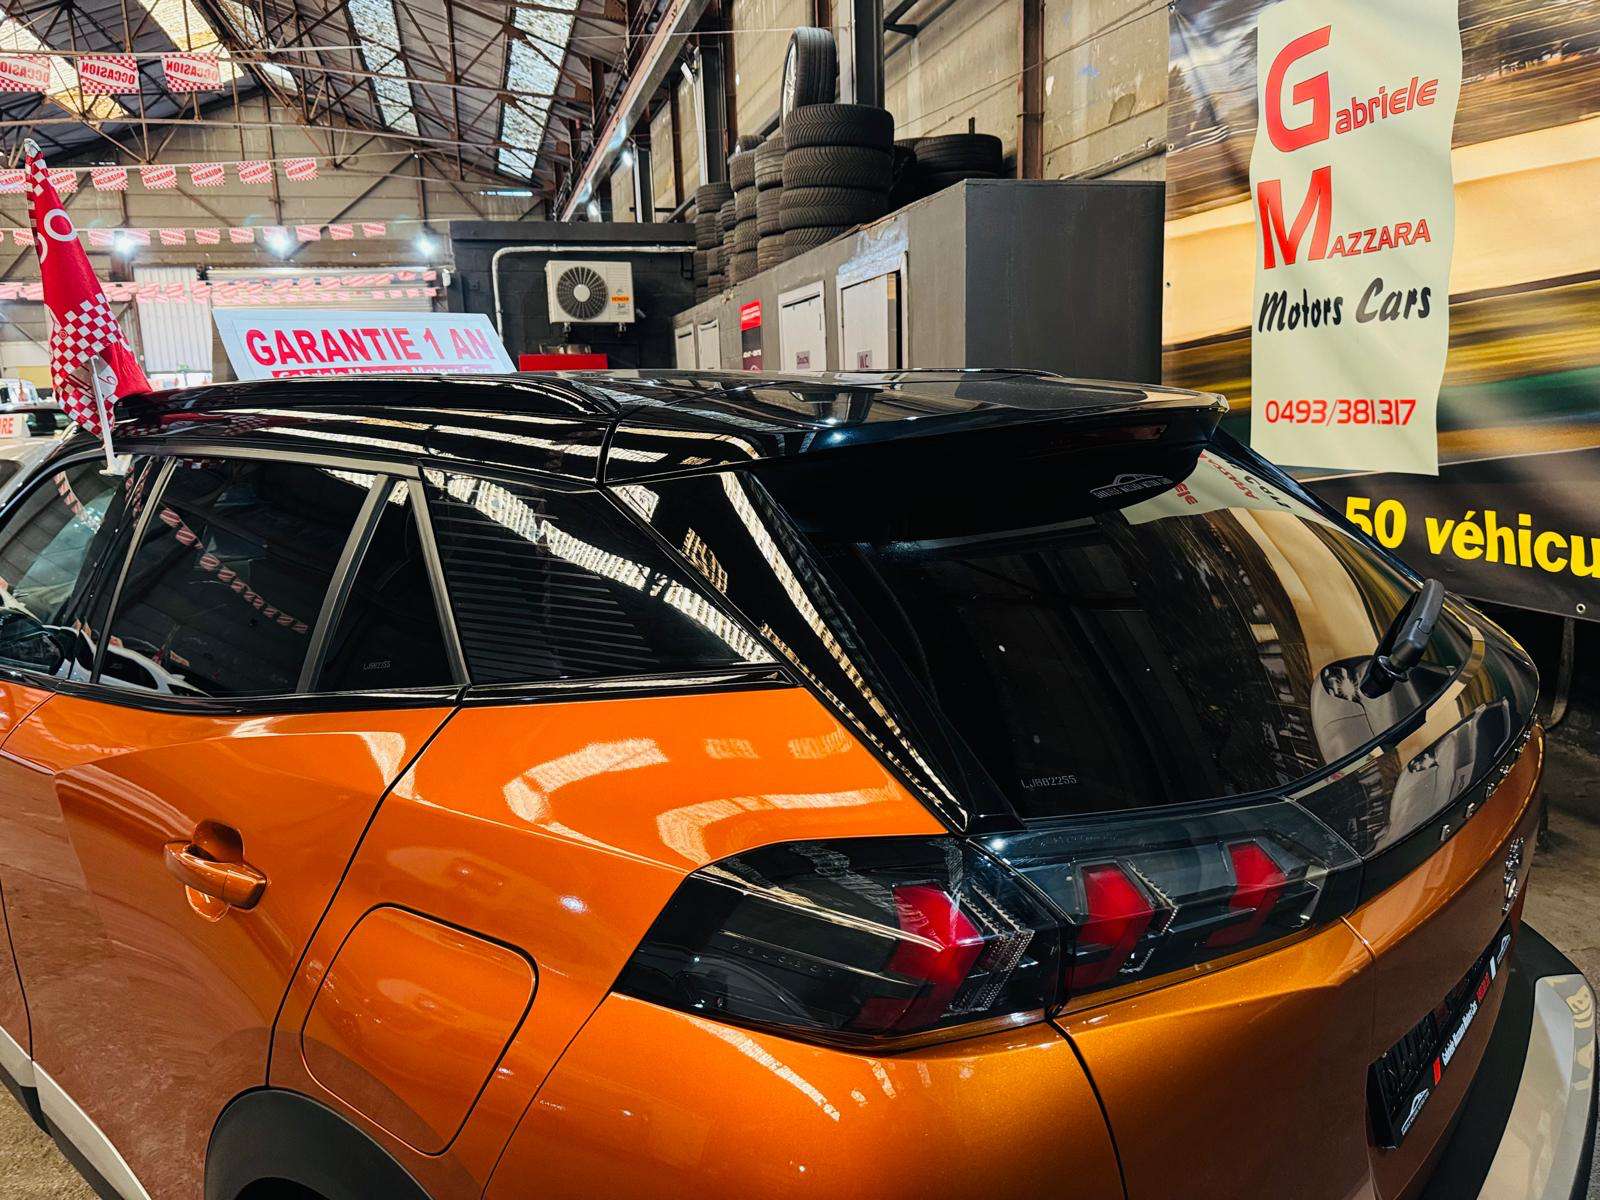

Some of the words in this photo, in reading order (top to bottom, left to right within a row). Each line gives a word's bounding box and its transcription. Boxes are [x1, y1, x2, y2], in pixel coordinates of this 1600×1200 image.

[1265, 25, 1438, 152] Gabriele
[1258, 288, 1344, 333] Motors
[1355, 277, 1432, 324] Cars
[245, 327, 423, 366] GARANTIE
[423, 327, 445, 360] 1
[449, 327, 496, 360] AN
[1345, 496, 1408, 549] 50
